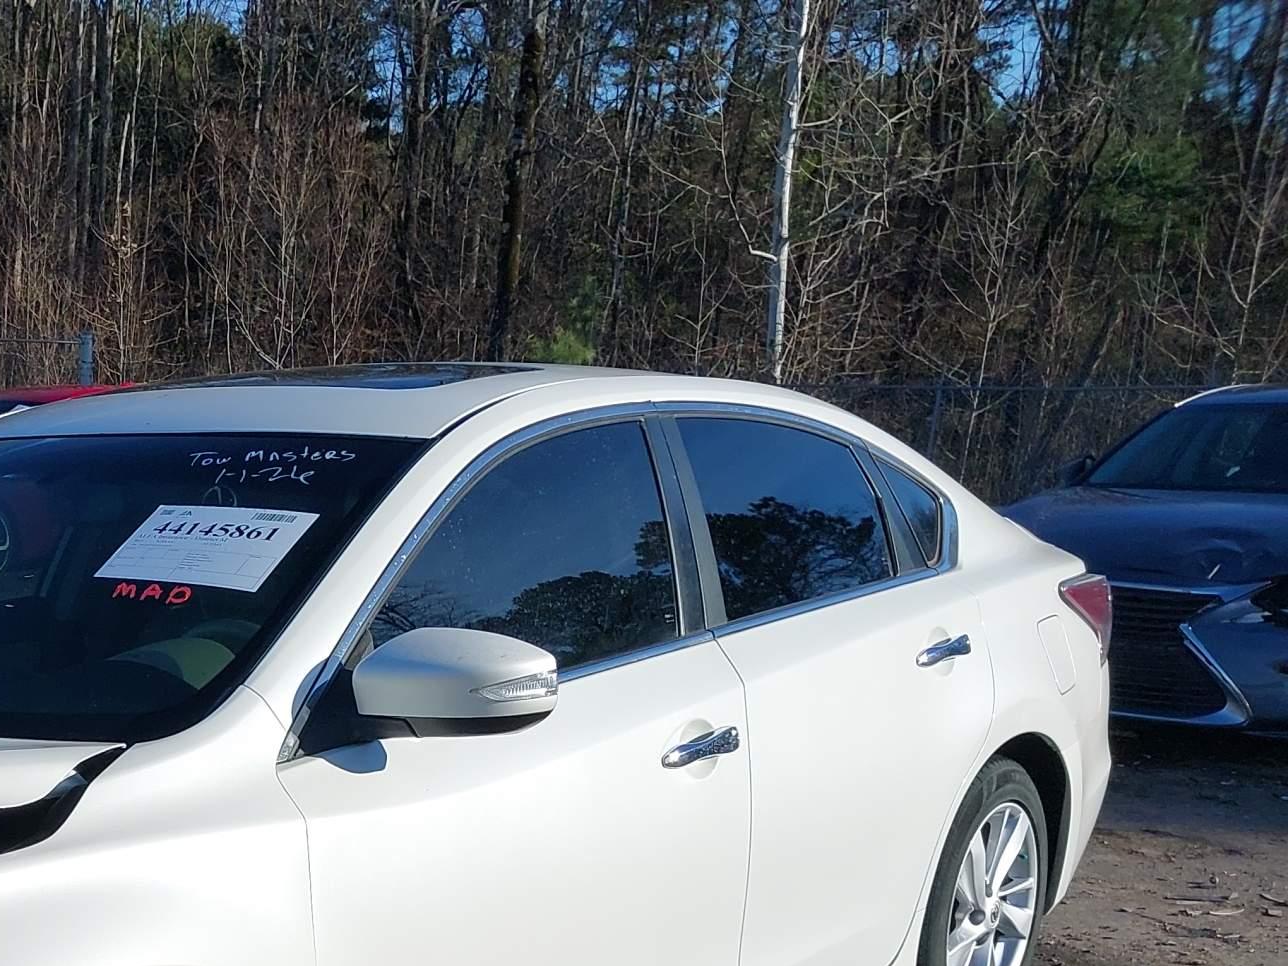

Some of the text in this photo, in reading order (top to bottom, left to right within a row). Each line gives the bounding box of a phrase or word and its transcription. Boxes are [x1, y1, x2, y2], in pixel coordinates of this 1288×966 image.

[189, 451, 232, 467] Tow
[153, 520, 281, 542] 44145861
[111, 582, 193, 605] MAD
